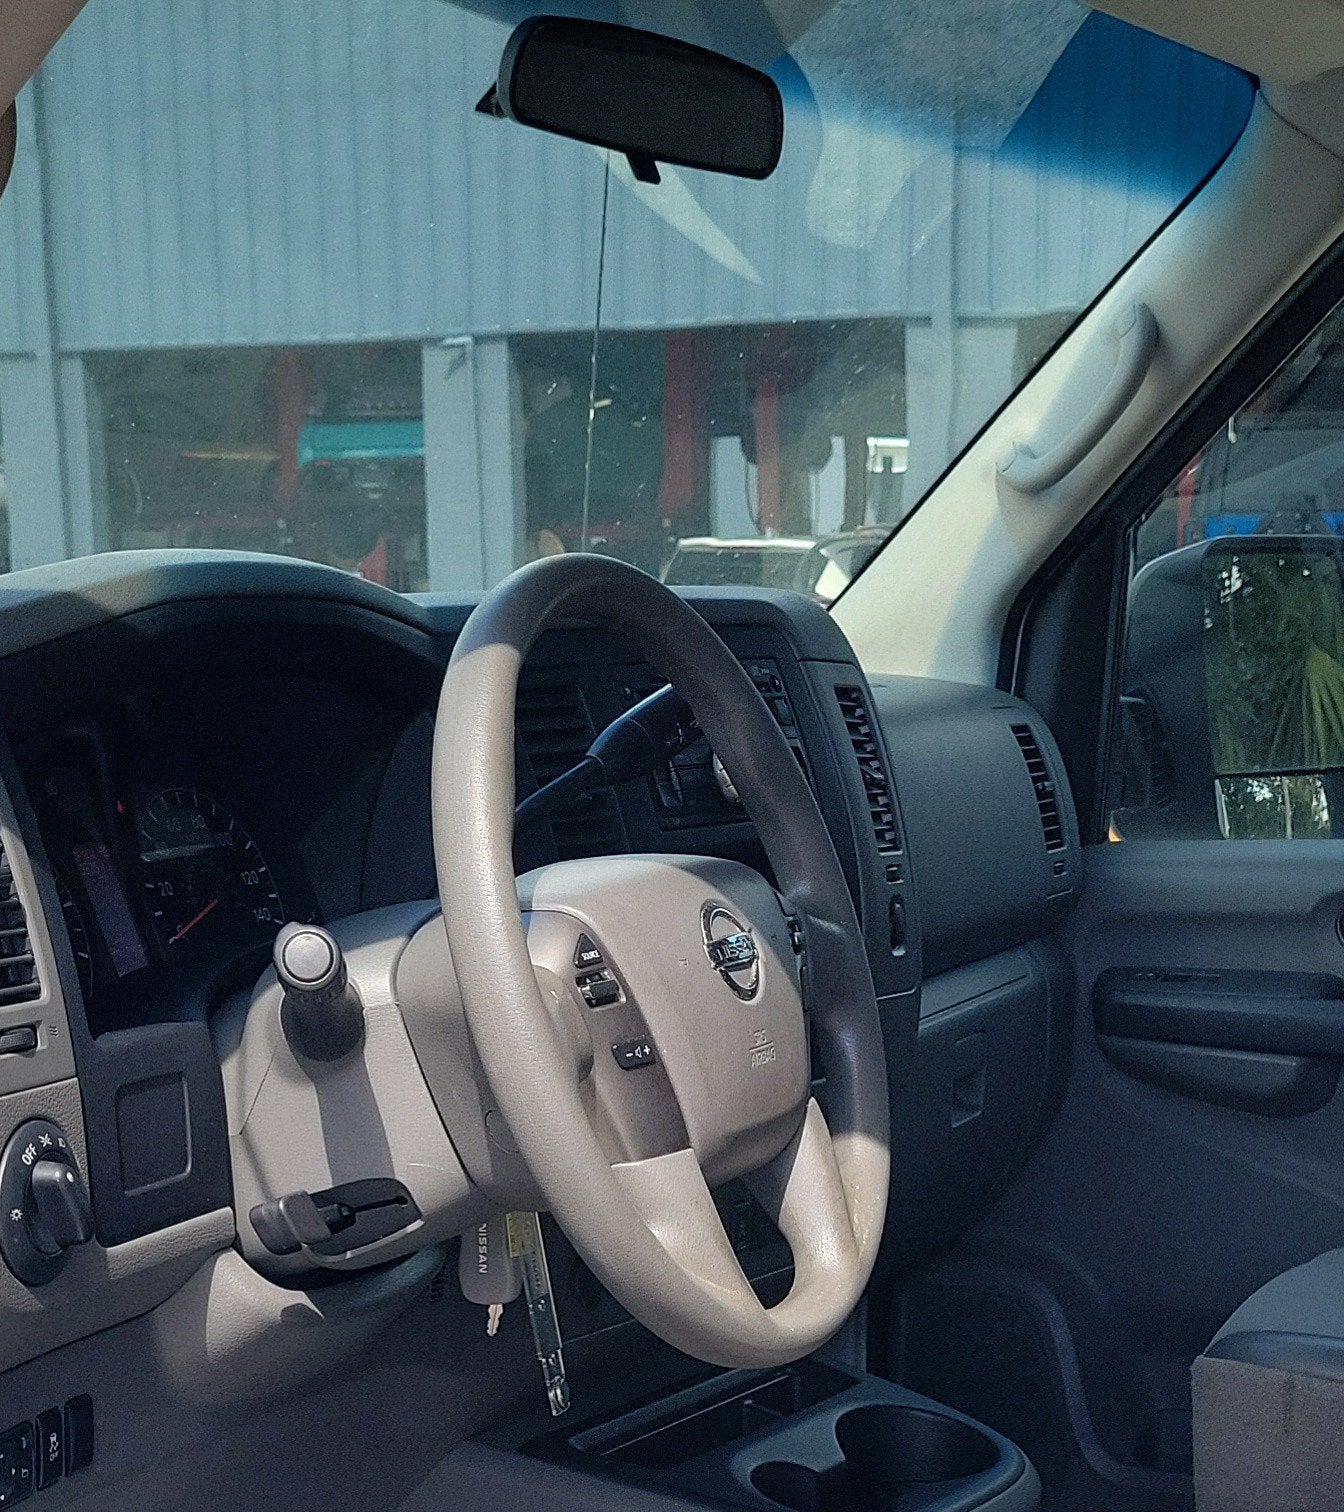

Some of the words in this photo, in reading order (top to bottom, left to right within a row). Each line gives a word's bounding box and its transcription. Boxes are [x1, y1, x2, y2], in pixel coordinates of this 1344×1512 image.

[240, 870, 259, 886] 120
[158, 881, 174, 897] 20
[252, 906, 272, 922] 140
[751, 1046, 776, 1067] AIRBAG
[21, 1143, 37, 1165] OFF
[478, 1223, 488, 1275] NISSAN
